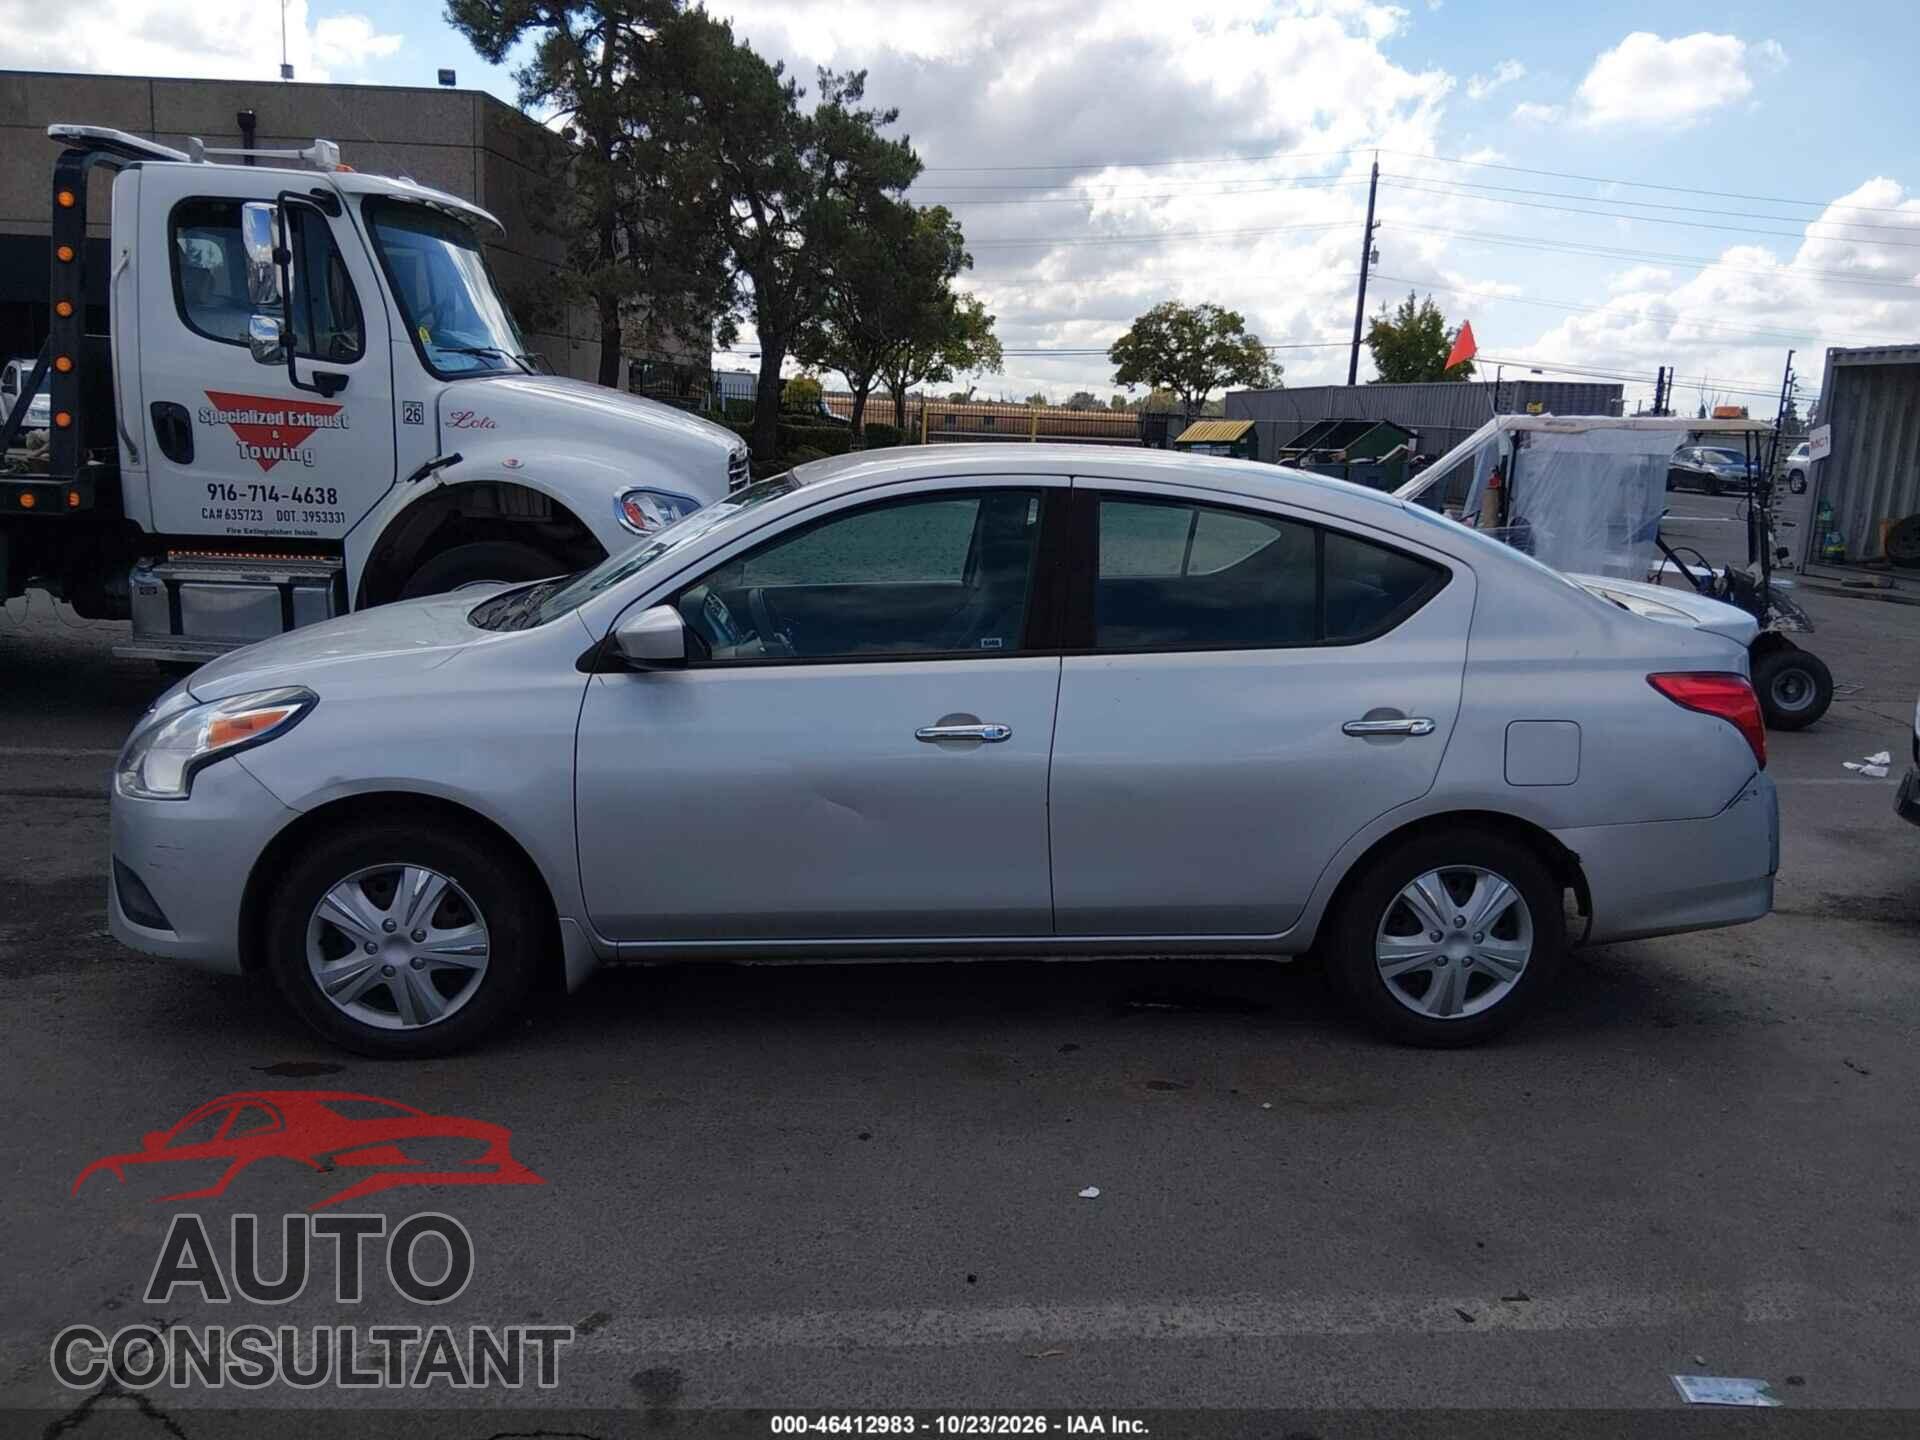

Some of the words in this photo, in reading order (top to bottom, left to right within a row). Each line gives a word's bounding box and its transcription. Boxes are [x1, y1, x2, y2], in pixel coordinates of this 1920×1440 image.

[199, 407, 285, 426] Specialized
[287, 411, 350, 430] Exhaust
[405, 407, 421, 423] 26
[445, 411, 497, 429] Lola
[271, 430, 280, 439] &
[237, 440, 315, 468] Towing
[207, 483, 338, 505] 916-714-4638
[302, 510, 346, 524] 3953331
[226, 527, 242, 535] Fire
[244, 528, 293, 537] Extinguisher
